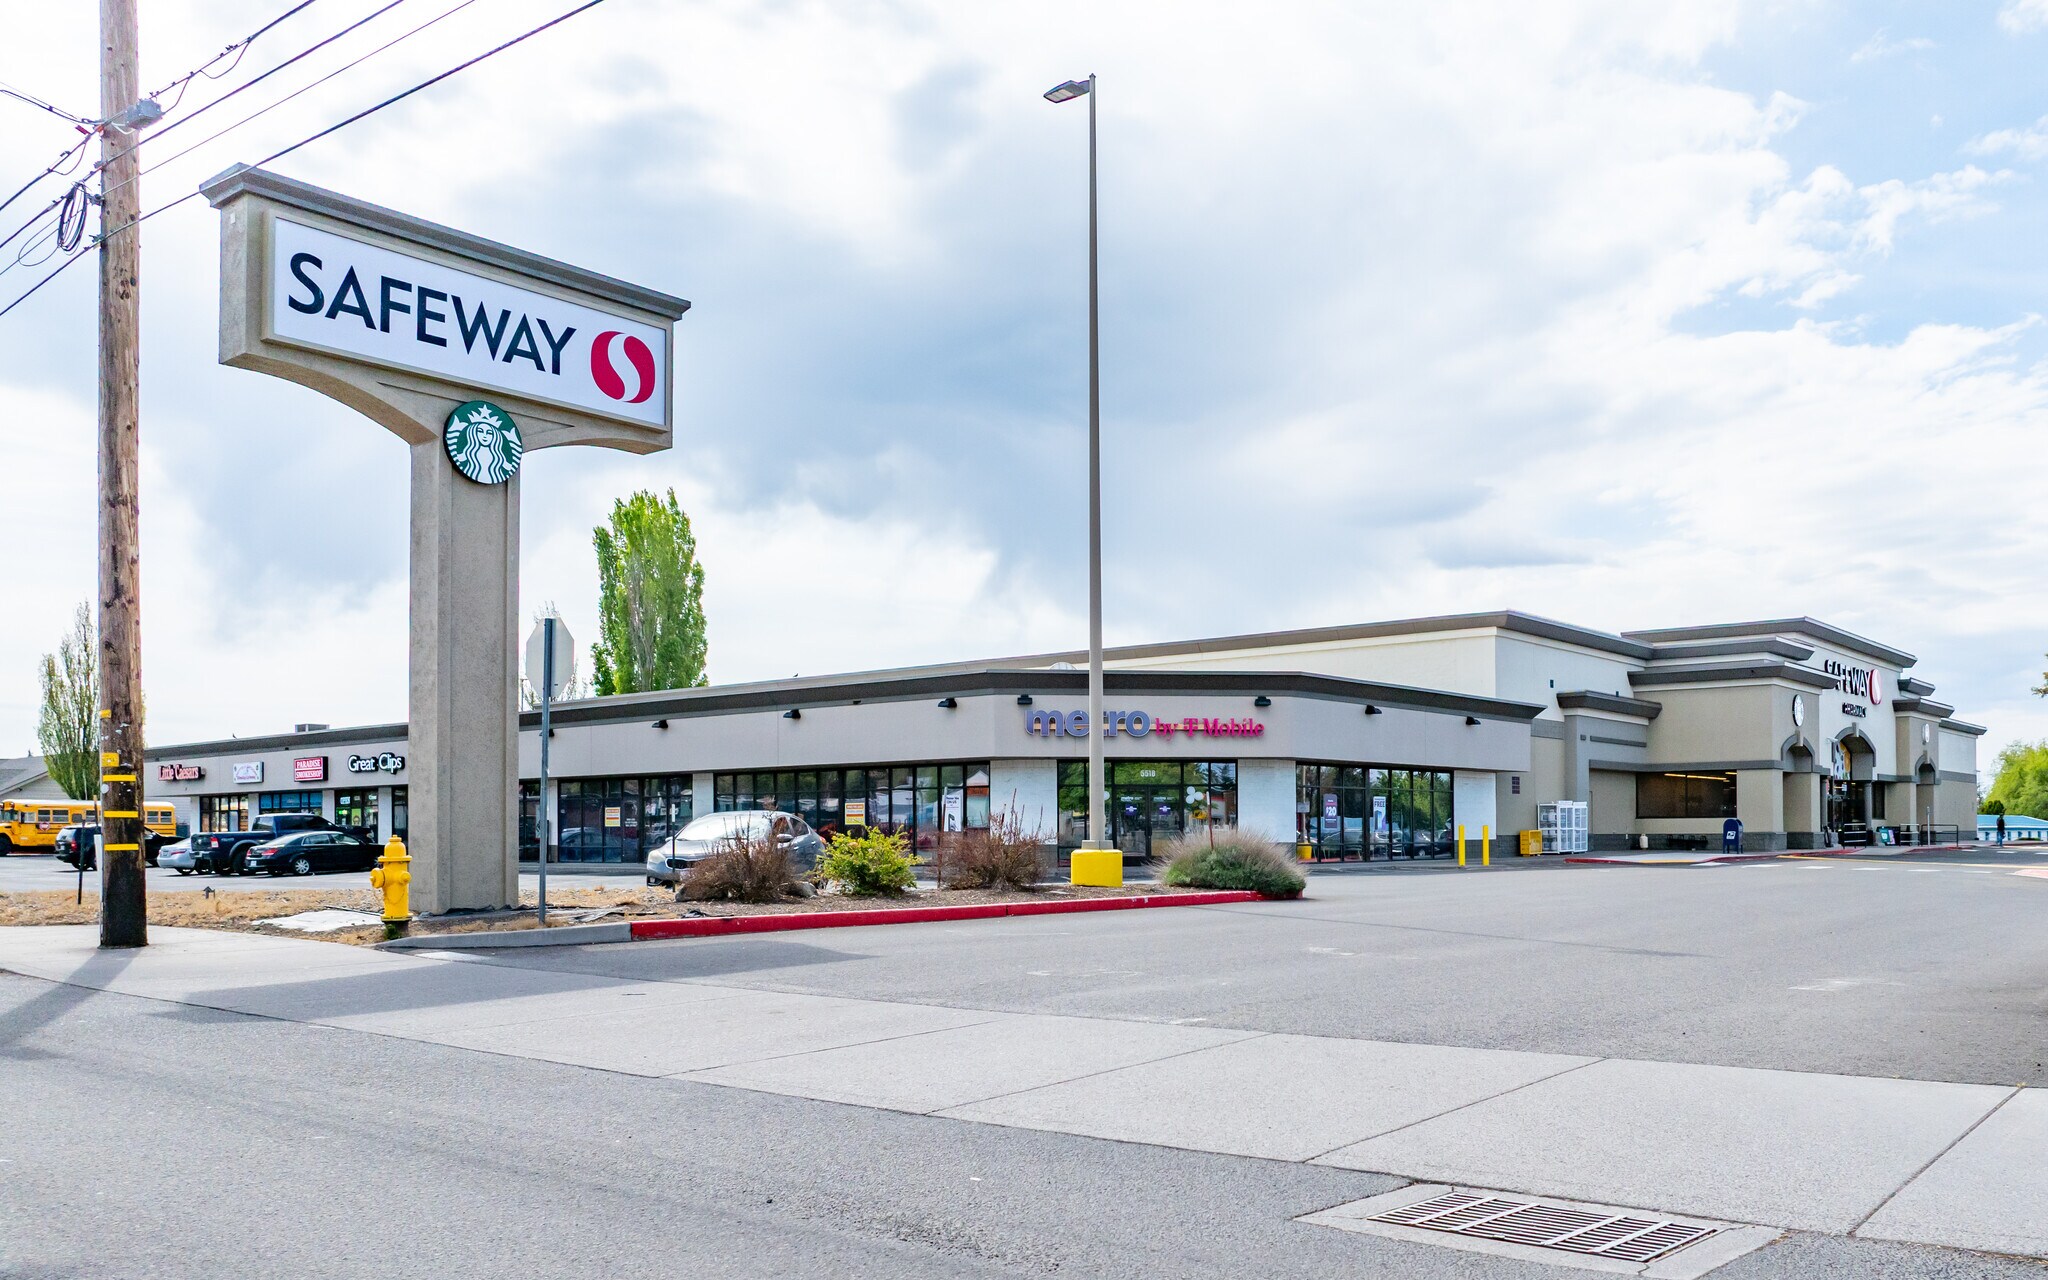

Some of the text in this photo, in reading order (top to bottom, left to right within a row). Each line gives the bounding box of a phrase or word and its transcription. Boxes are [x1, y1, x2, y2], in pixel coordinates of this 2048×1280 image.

[288, 252, 576, 376] SAFEWAY
[1025, 709, 1150, 737] mero
[1155, 717, 1178, 741] by
[296, 759, 321, 769] PARADISE
[348, 754, 402, 773] Great Clips
[158, 764, 199, 780] Little Caesars
[1140, 769, 1156, 777] 5518
[1326, 806, 1337, 817] $20
